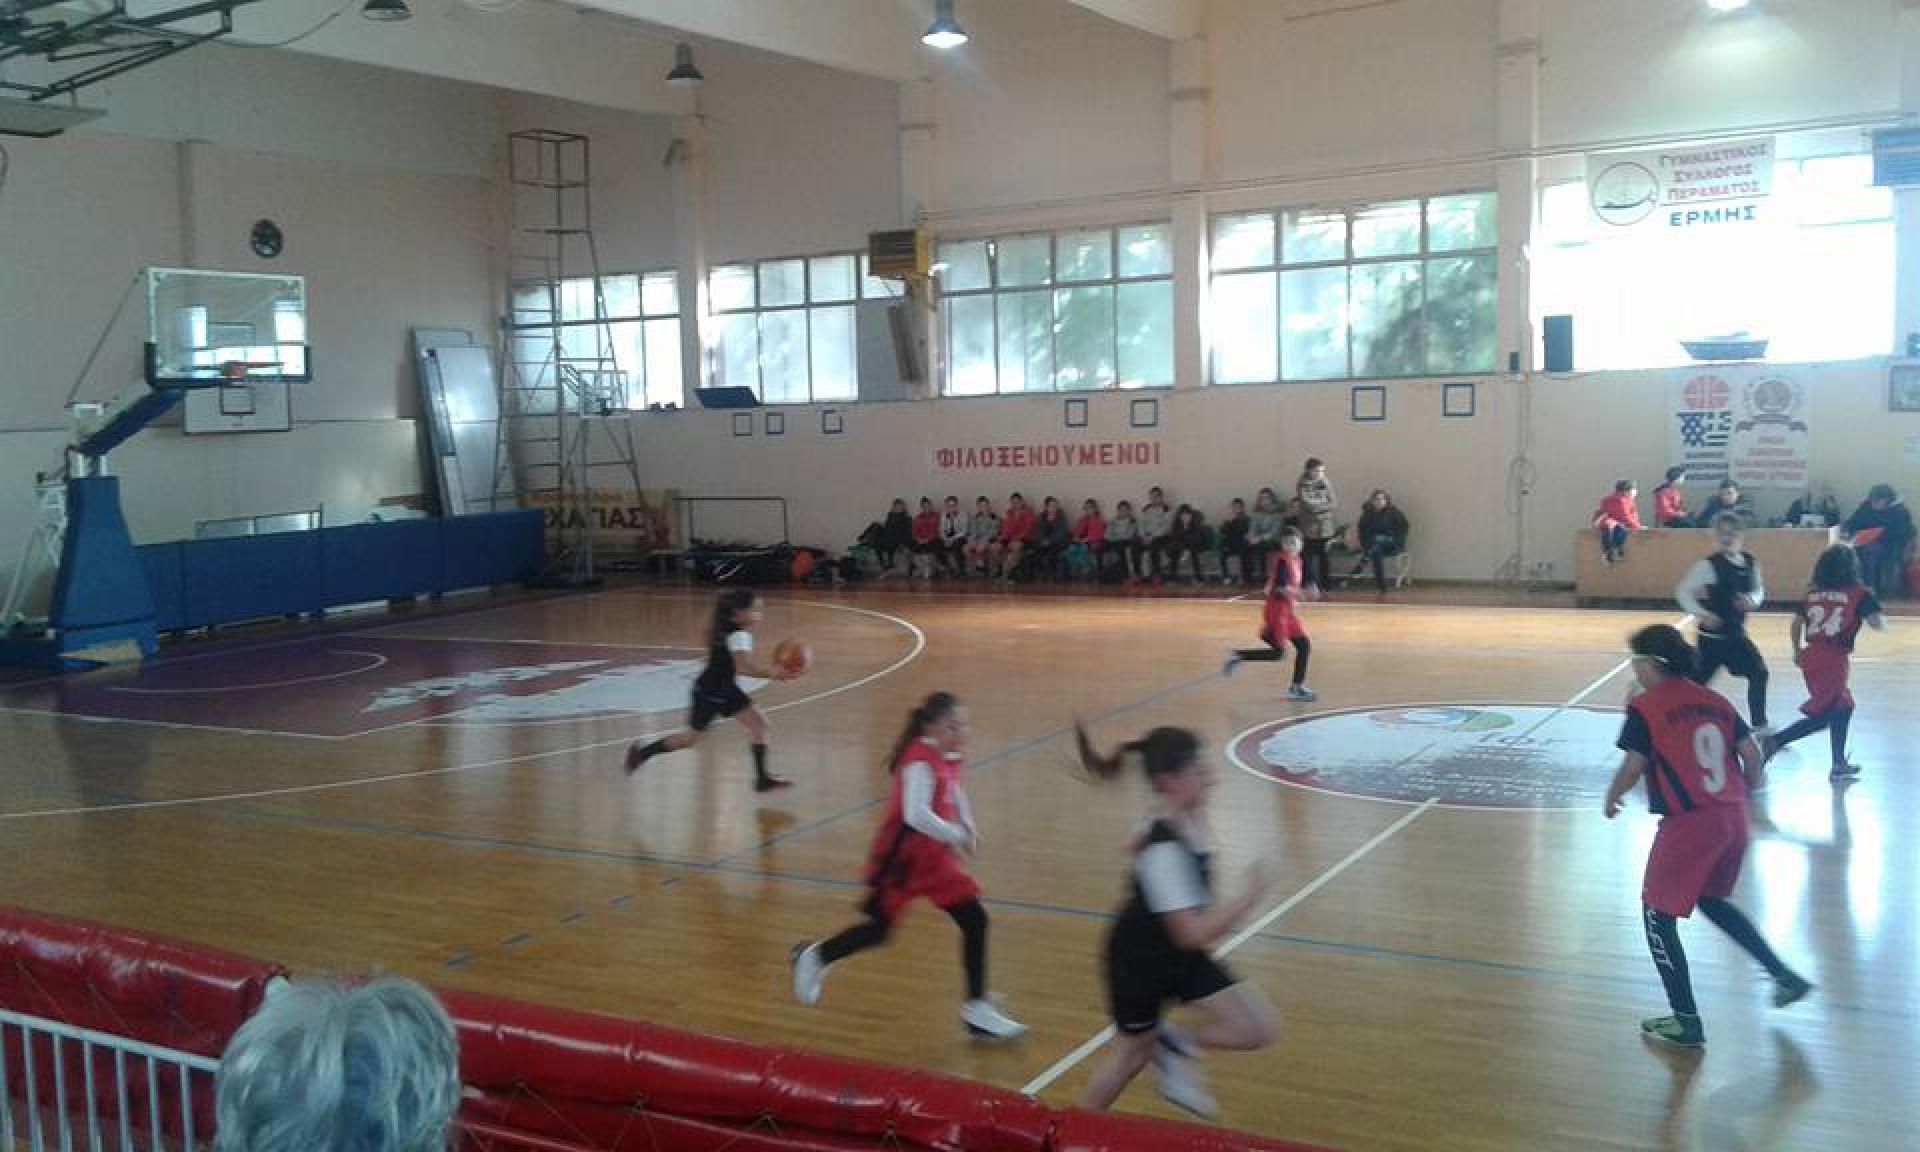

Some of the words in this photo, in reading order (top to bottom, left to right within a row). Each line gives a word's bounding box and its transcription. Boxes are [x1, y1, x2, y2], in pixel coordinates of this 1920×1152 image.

[1669, 204, 1757, 227] ΕΡΜΗΣ
[936, 440, 1161, 470] ΦΙΛΟΞΕΝΟΥΜΕΝΟΙ
[1807, 605, 1845, 637] 24
[1693, 722, 1727, 796] 9
